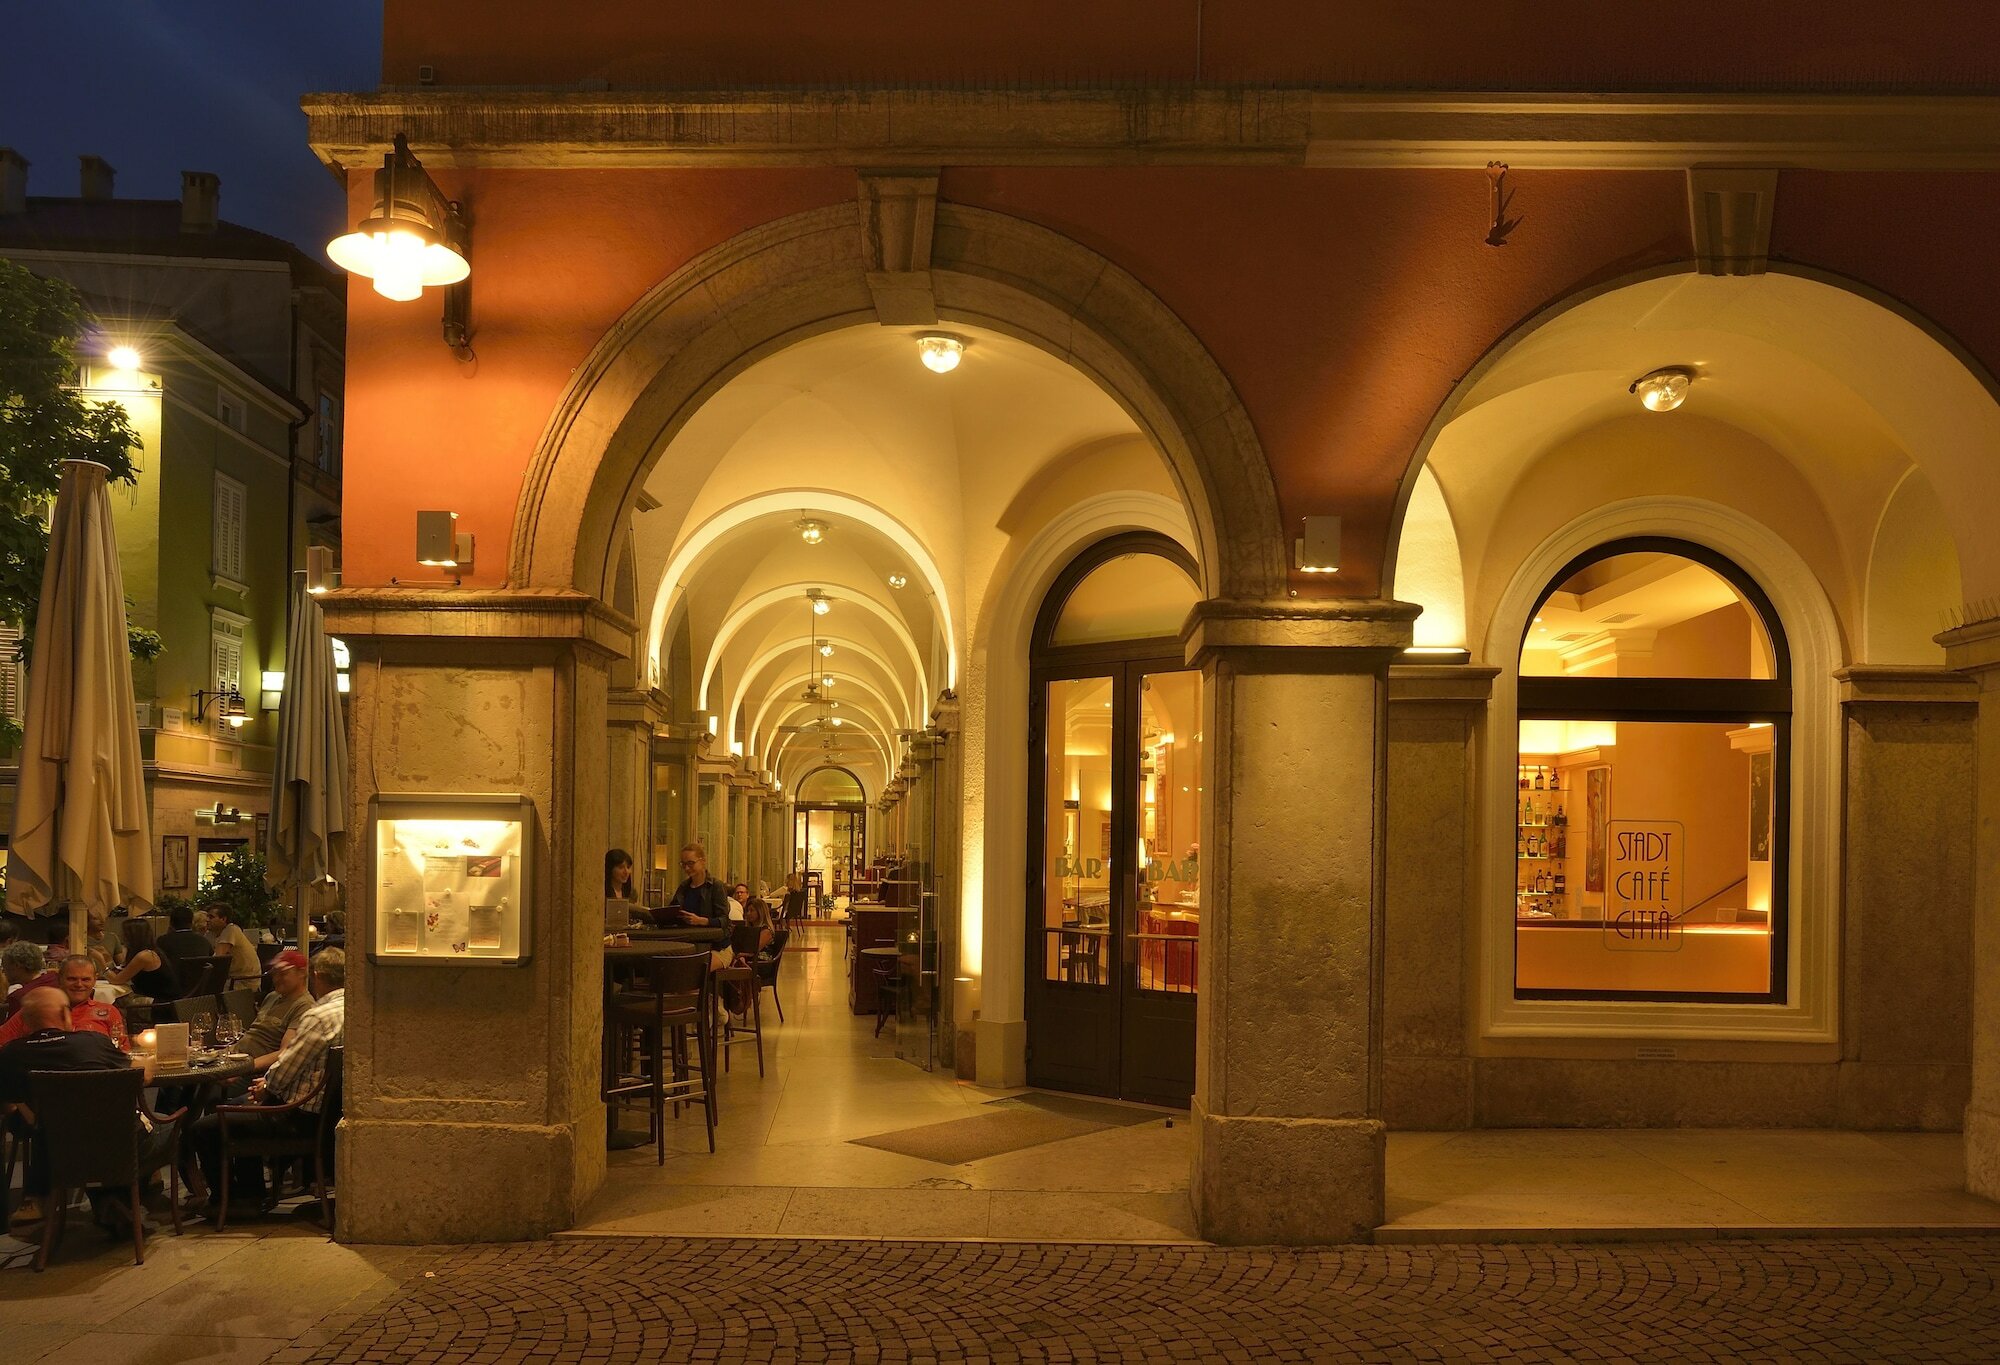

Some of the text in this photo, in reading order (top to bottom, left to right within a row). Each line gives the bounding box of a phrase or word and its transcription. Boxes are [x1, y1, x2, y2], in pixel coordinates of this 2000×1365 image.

[1616, 831, 1672, 862] STADT
[1055, 857, 1102, 879] BAR
[1148, 860, 1199, 882] BAR
[1616, 866, 1670, 901] CAFÉ
[1616, 905, 1670, 940] CITTÀ
